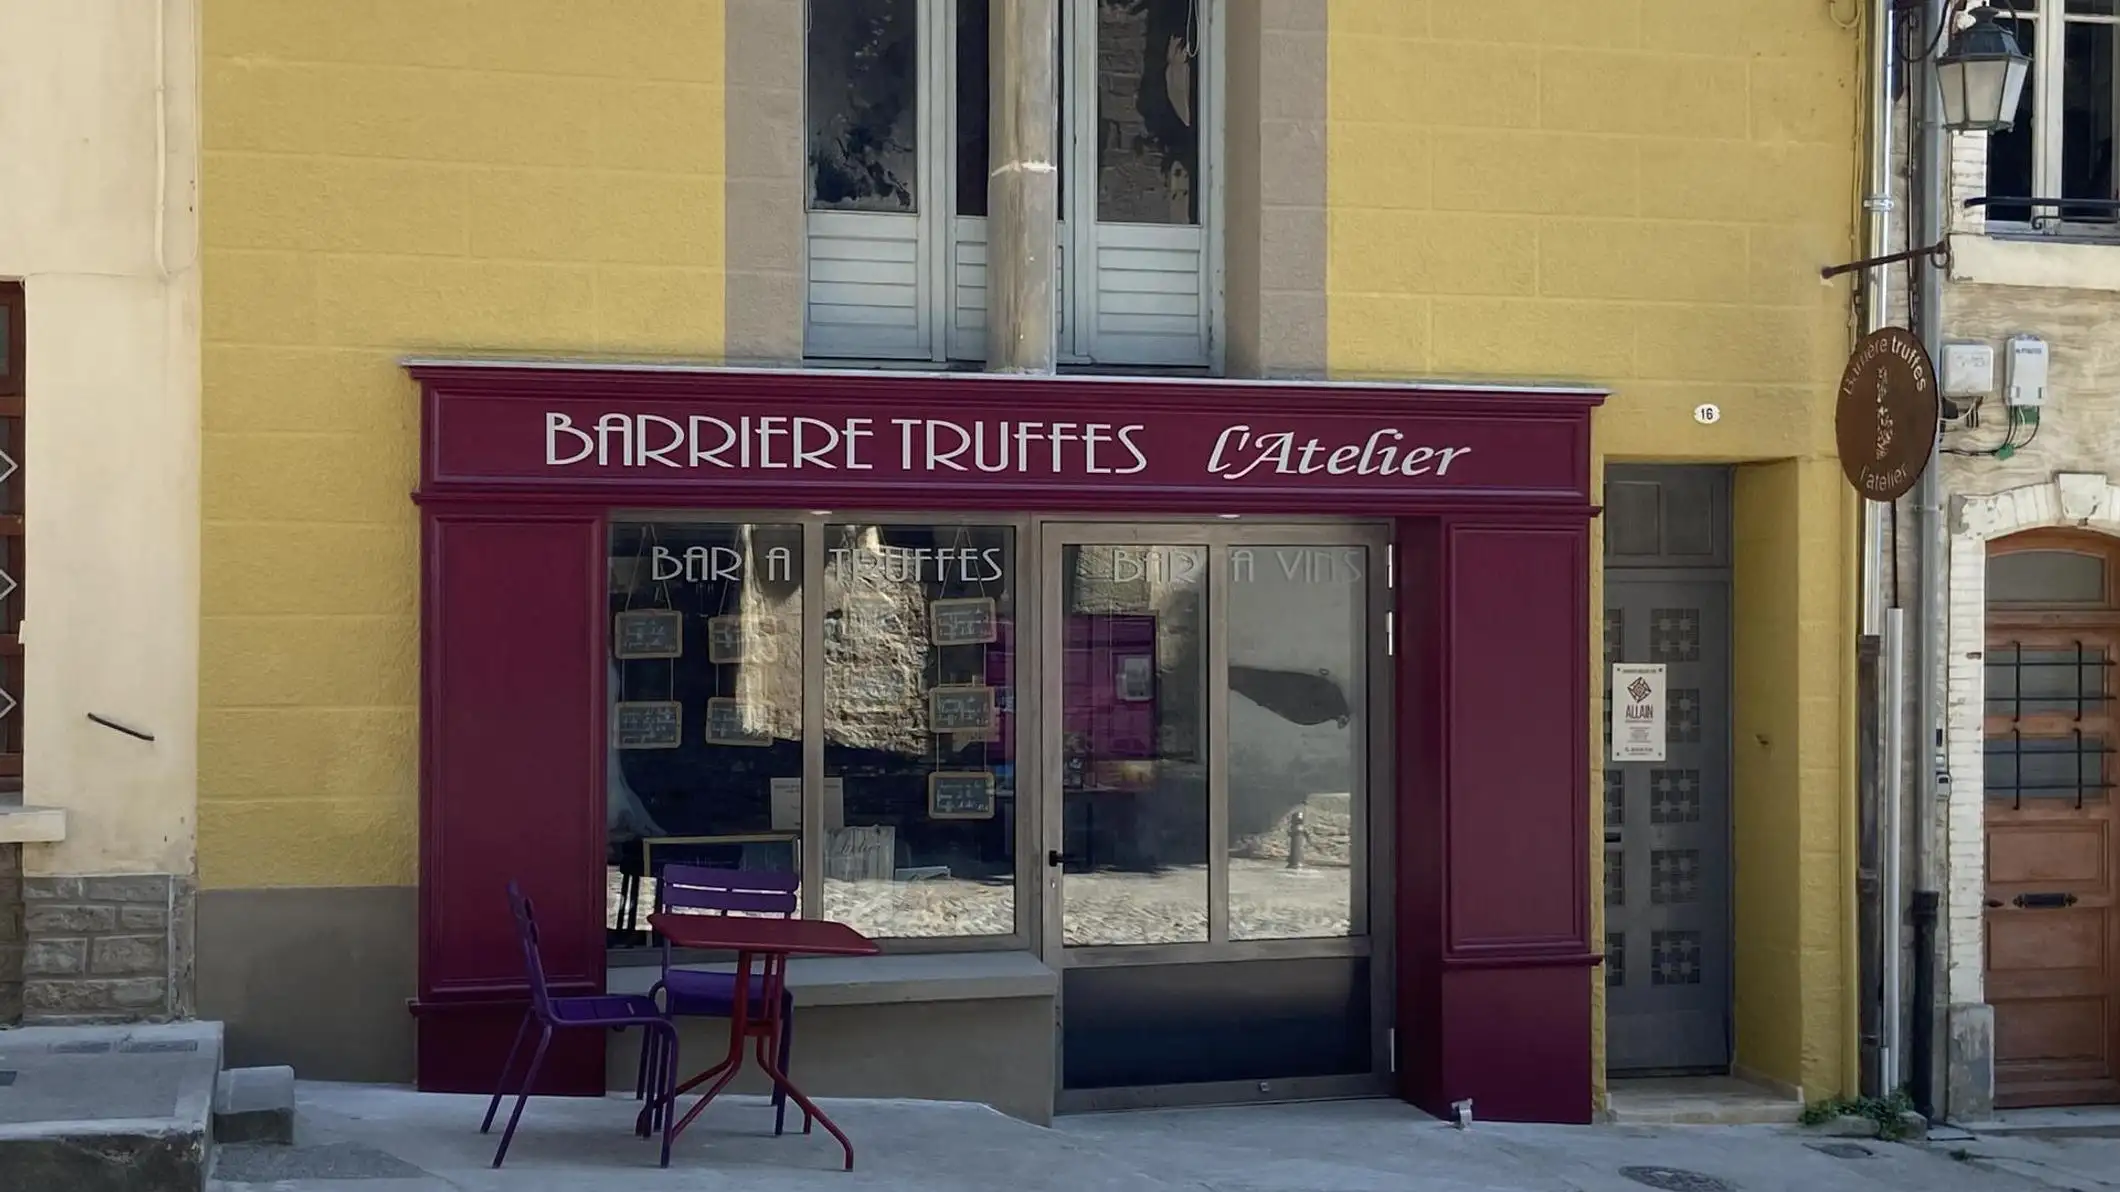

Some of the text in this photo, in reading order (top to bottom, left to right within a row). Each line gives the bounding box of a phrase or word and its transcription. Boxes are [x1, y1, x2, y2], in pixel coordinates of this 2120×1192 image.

[1892, 335, 1927, 392] truffes
[1702, 407, 1713, 420] 16
[545, 411, 1472, 480] BARRIERE TRUFFES l'Atelier
[652, 546, 1002, 583] BAR A TRUFFES
[1113, 549, 1363, 585] BAR A VINS
[1625, 704, 1654, 719] ALLAIN
